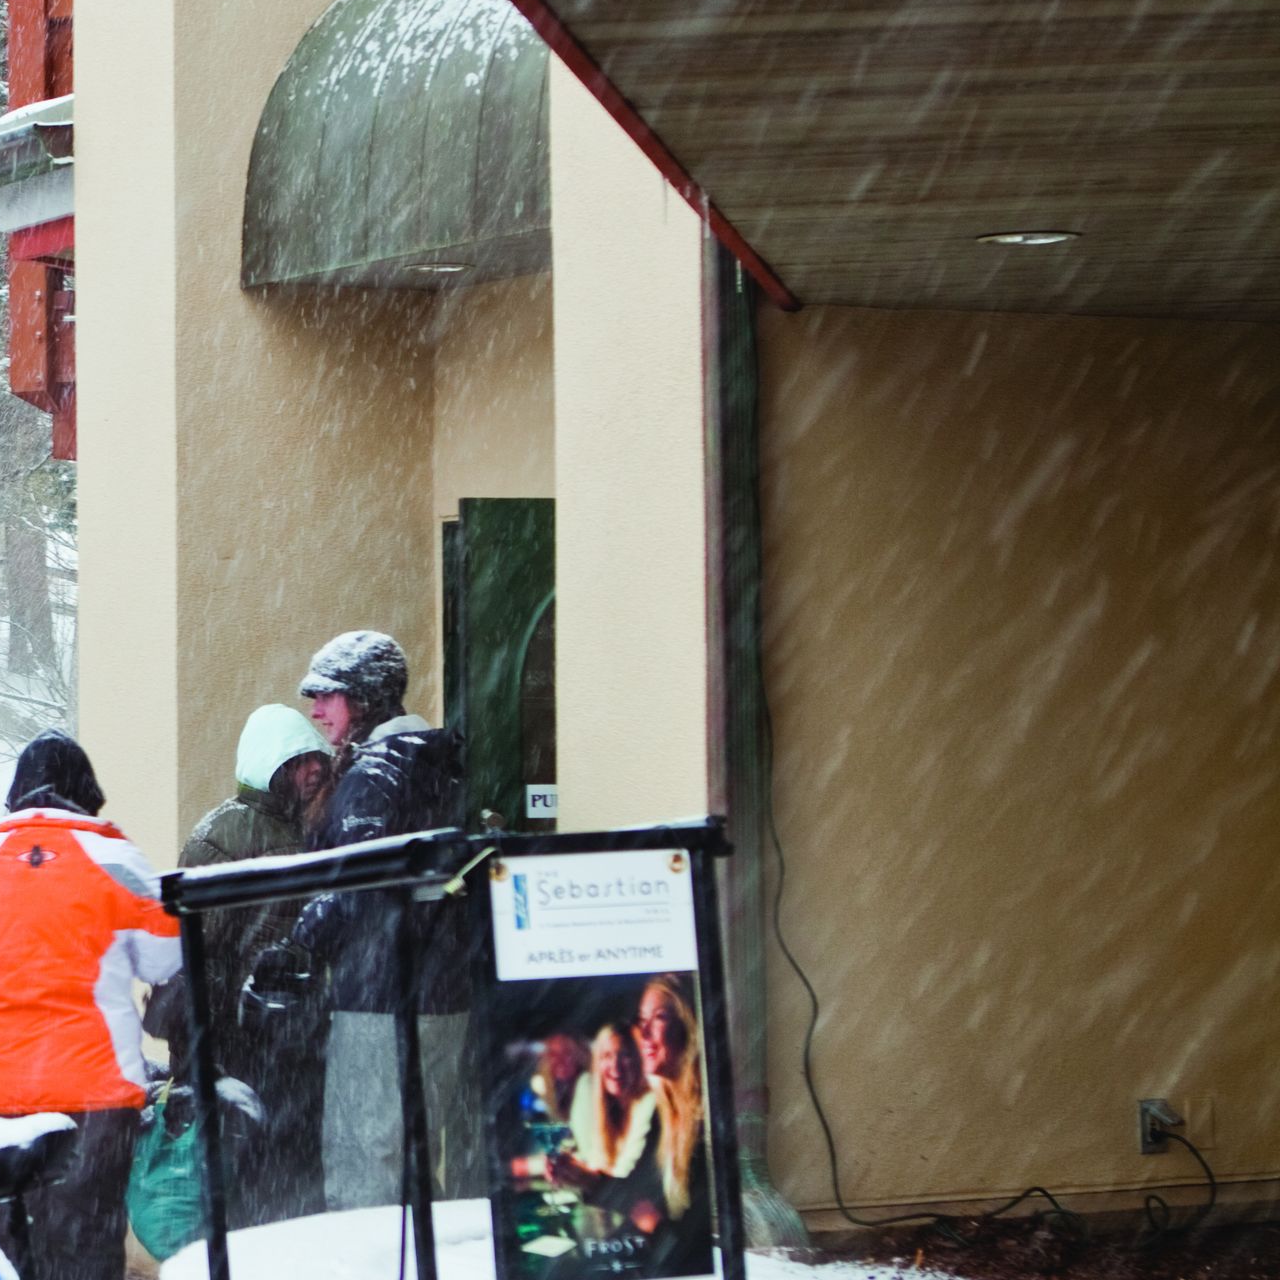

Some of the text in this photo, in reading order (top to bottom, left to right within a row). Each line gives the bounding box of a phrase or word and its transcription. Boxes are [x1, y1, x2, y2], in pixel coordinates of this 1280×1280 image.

[537, 876, 670, 906] Sebastian
[595, 945, 664, 961] ANYTIME
[583, 1236, 646, 1258] FROST
